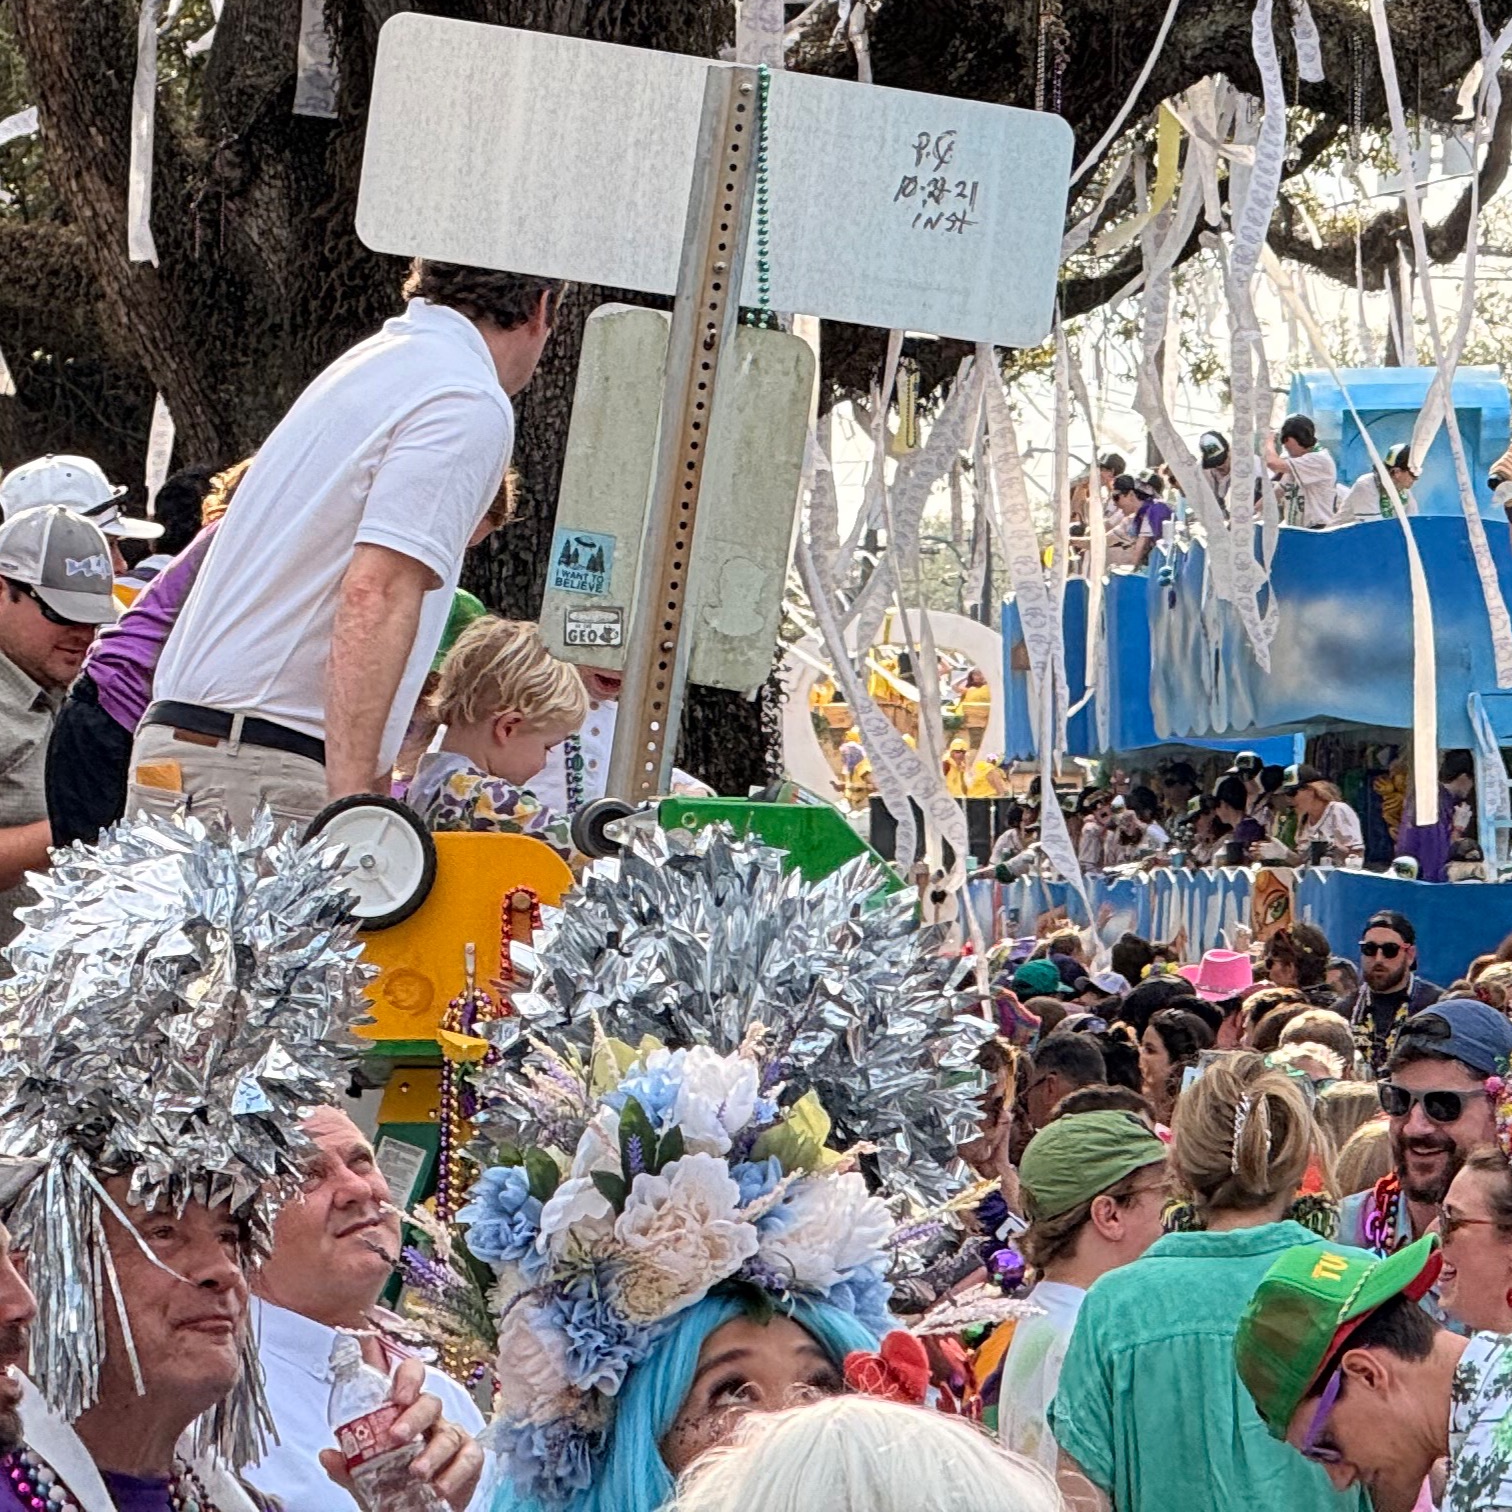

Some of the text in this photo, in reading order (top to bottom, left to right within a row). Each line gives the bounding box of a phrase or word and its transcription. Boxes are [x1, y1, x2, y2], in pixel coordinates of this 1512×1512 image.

[561, 569, 589, 581] WANT
[592, 575, 605, 584] TO
[555, 577, 604, 594] BELIEVE
[568, 629, 598, 643] GEO
